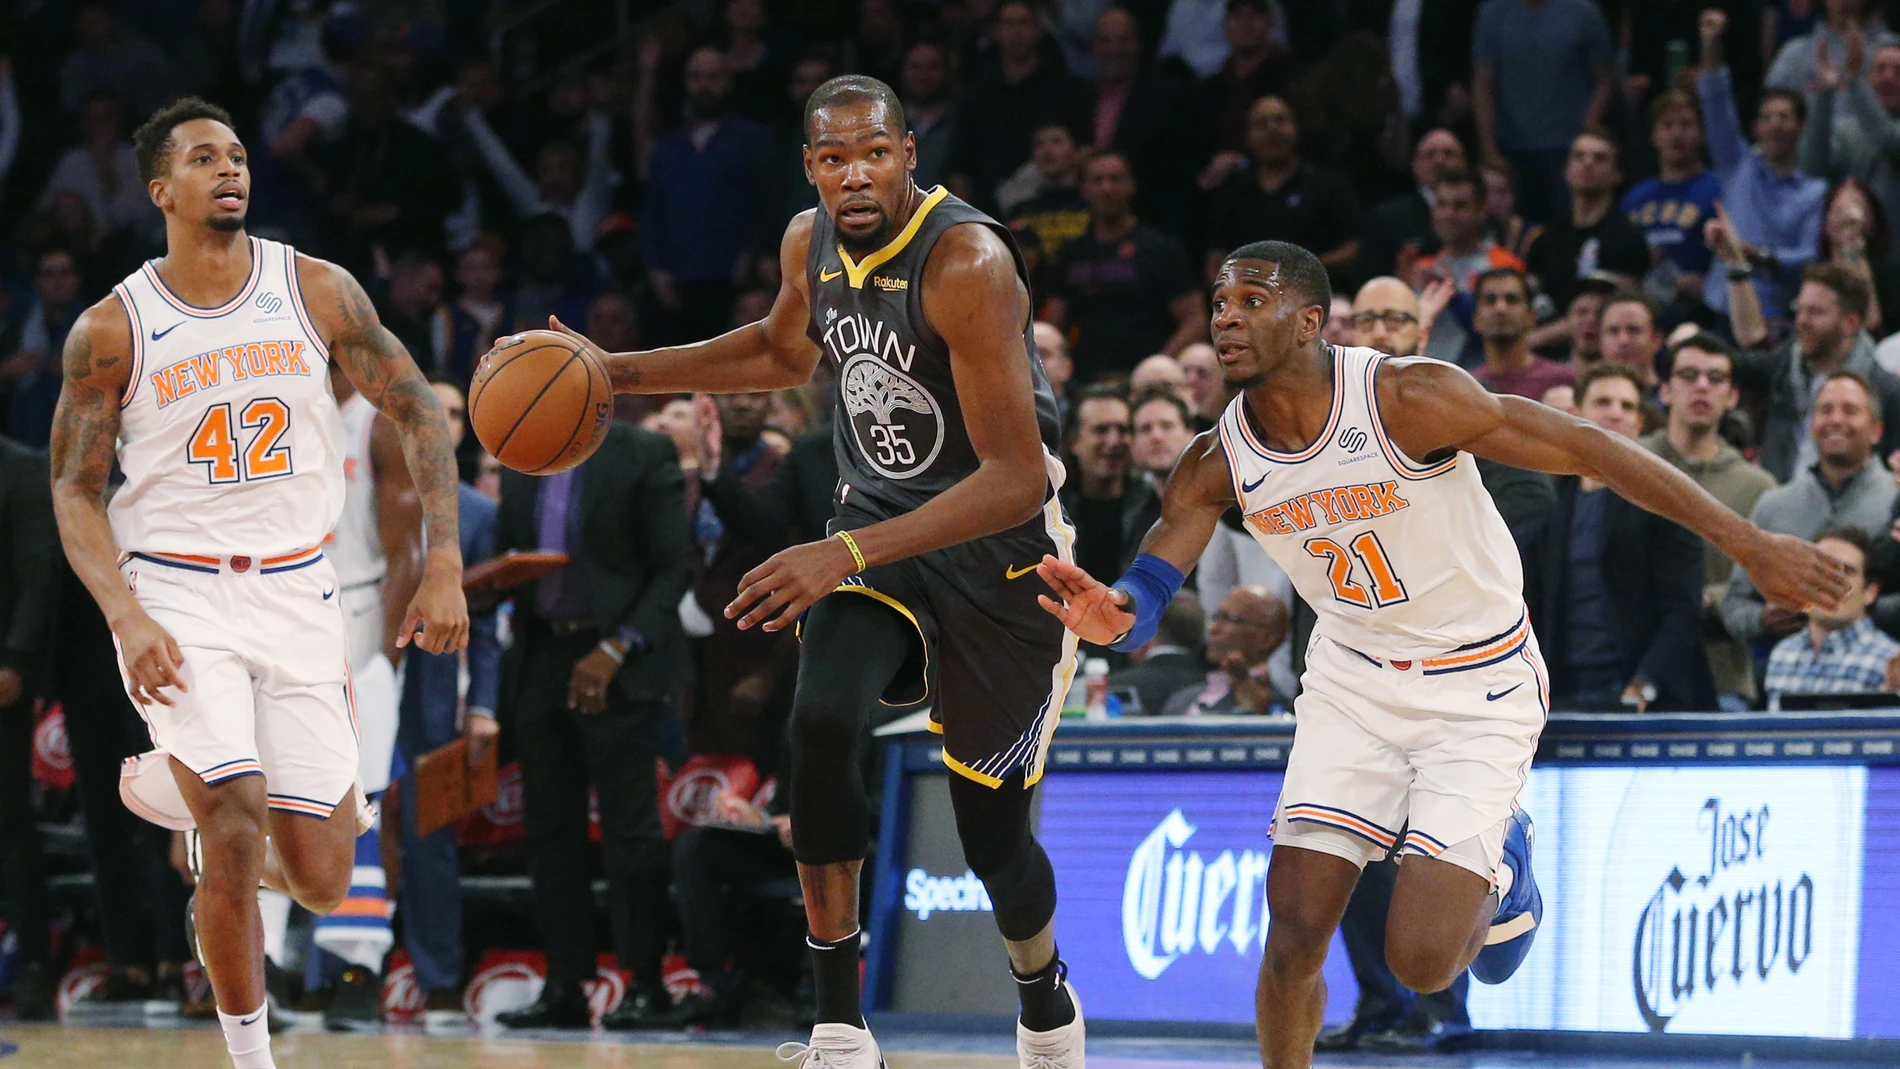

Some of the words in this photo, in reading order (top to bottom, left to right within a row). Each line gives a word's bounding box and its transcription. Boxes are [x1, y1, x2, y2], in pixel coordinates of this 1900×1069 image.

[873, 276, 908, 290] Rakuten
[253, 316, 291, 324] SQUARESPACE
[823, 313, 916, 372] TOWN
[151, 349, 221, 409] NEW
[222, 341, 311, 381] YORK
[187, 397, 293, 485] 42
[870, 424, 916, 465] 35
[1337, 452, 1379, 466] SQUARESPACE
[1244, 493, 1316, 535] NEW
[1309, 480, 1410, 525] YORK
[1303, 530, 1409, 610] 21
[1697, 798, 1770, 889] Jose
[904, 868, 994, 920] Spectr
[1122, 809, 1270, 980] Cuer
[1633, 864, 1813, 1032] Cuervo
